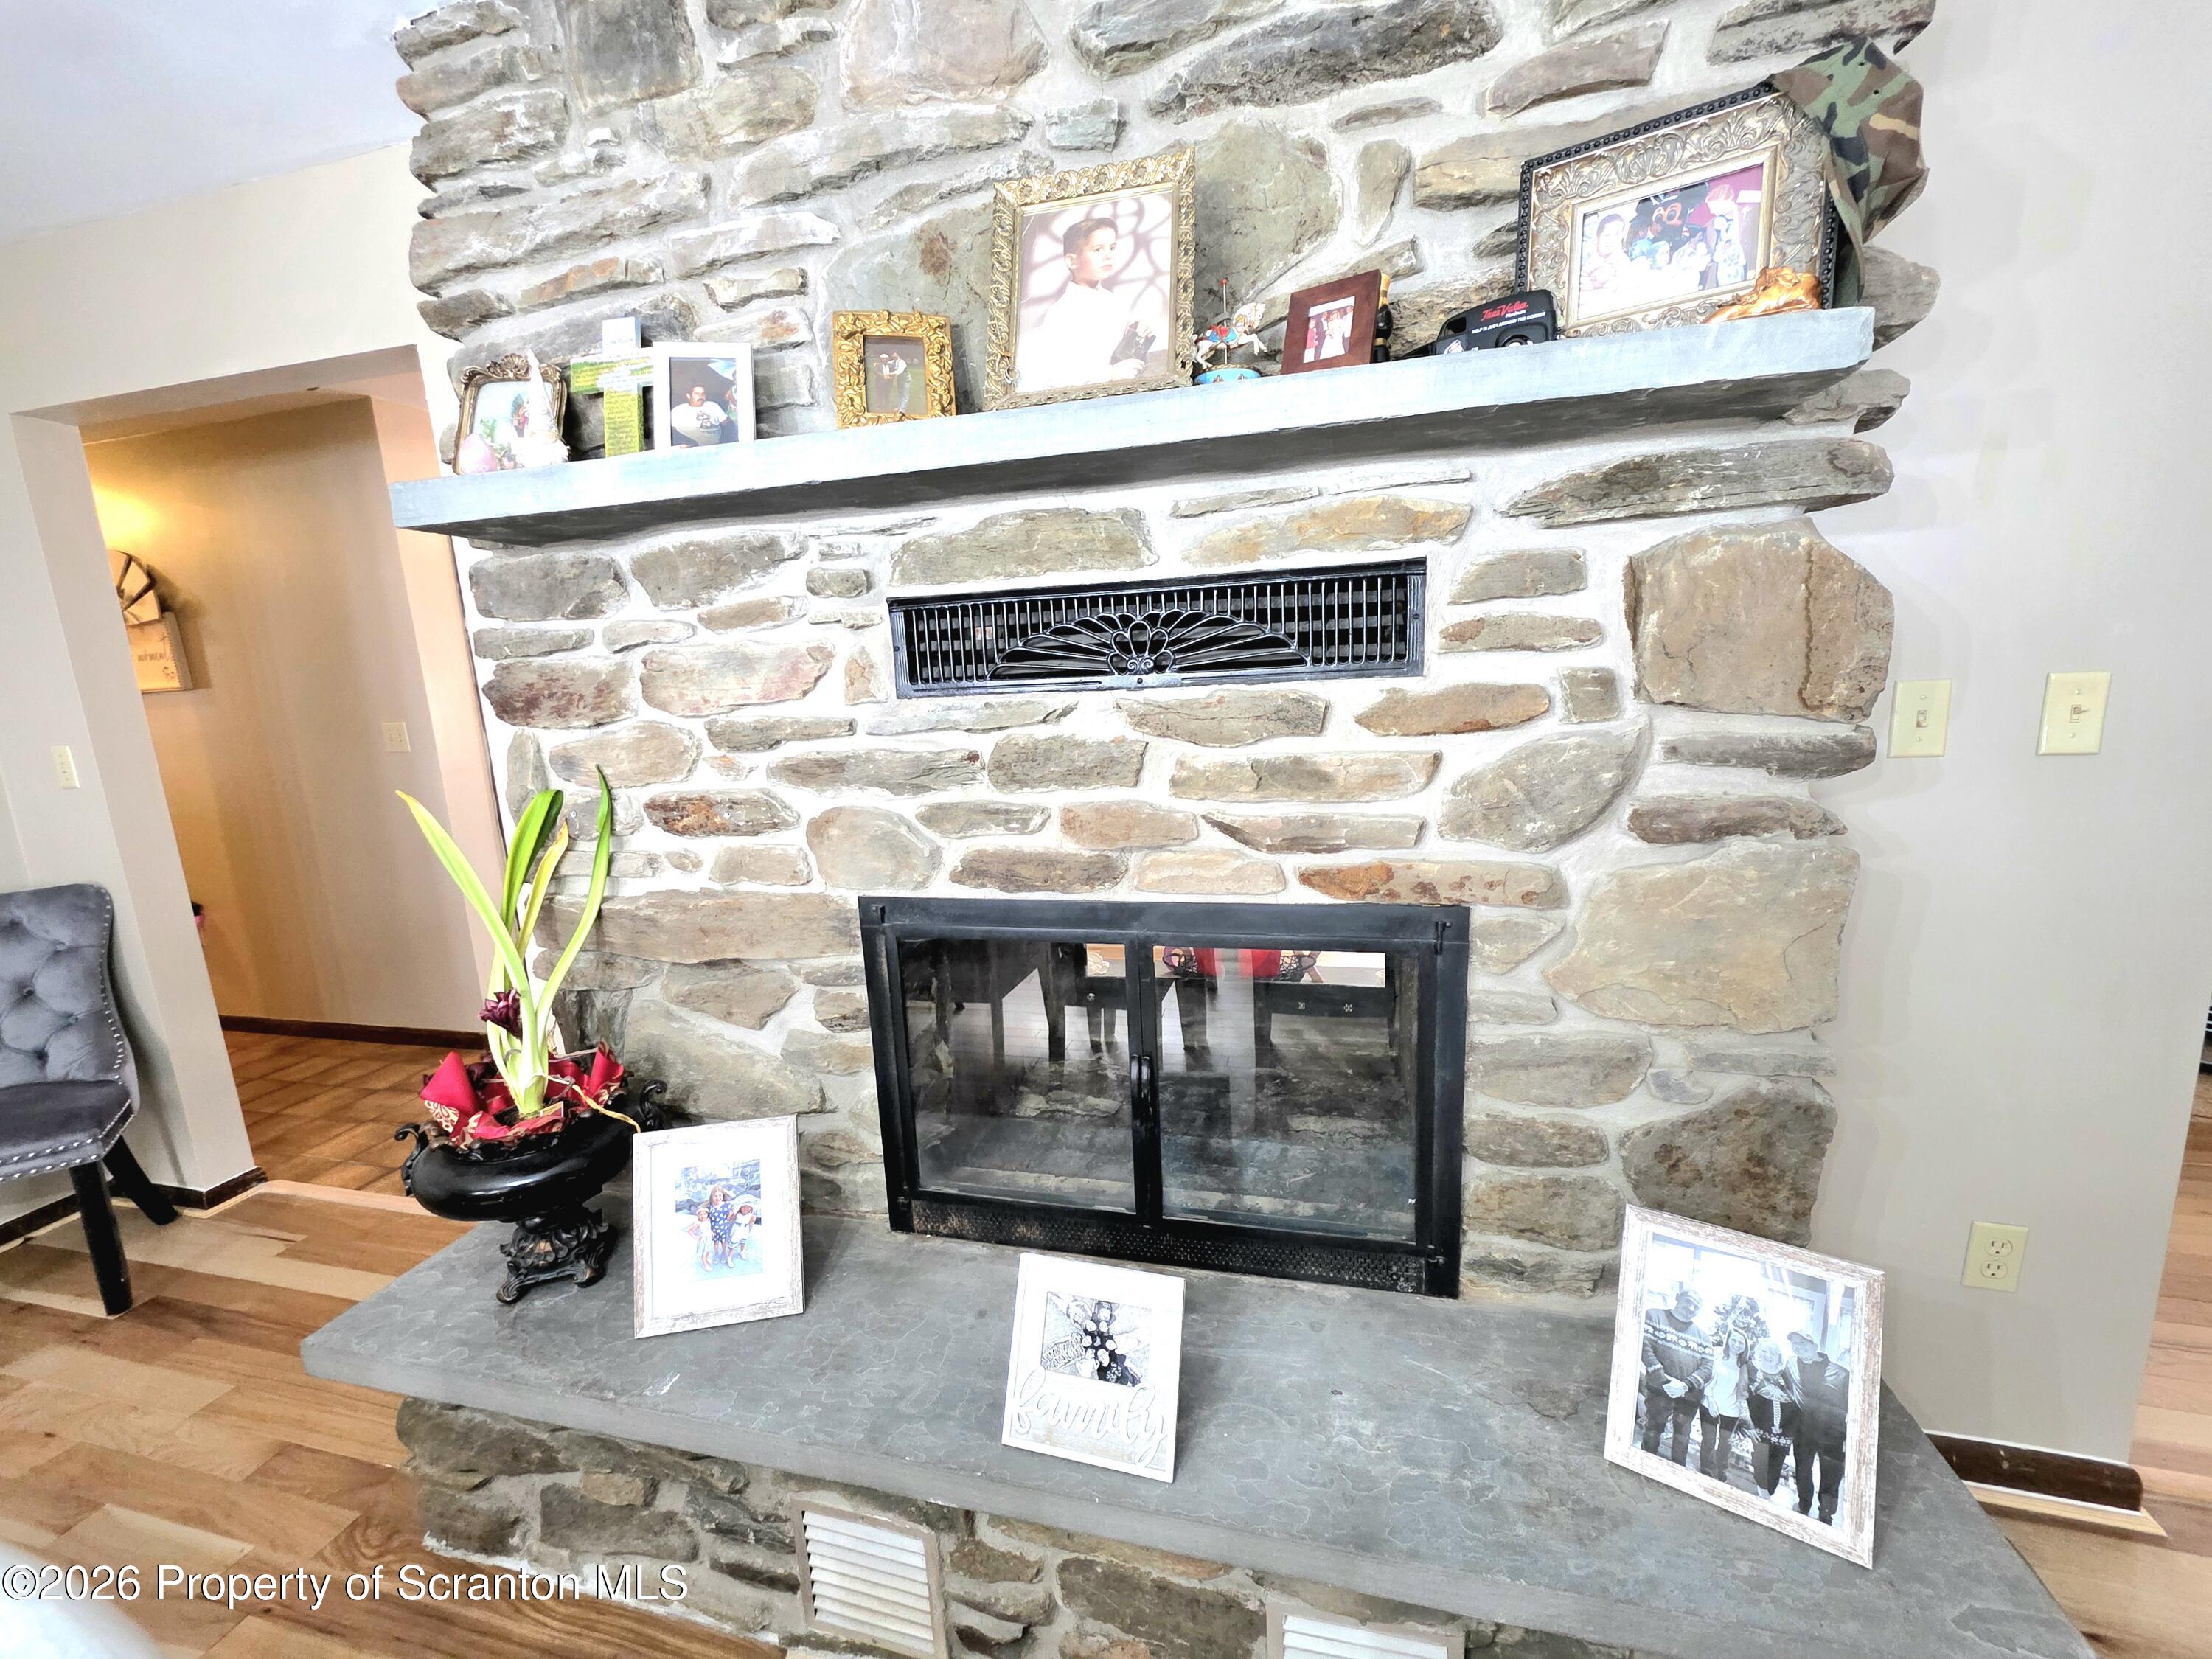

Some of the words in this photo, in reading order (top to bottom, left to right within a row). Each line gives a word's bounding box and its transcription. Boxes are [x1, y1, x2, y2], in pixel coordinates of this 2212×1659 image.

[1481, 308, 1500, 321] True
[1500, 301, 1528, 316] Value
[1498, 319, 1517, 327] AROUND
[1012, 1368, 1167, 1468] family
